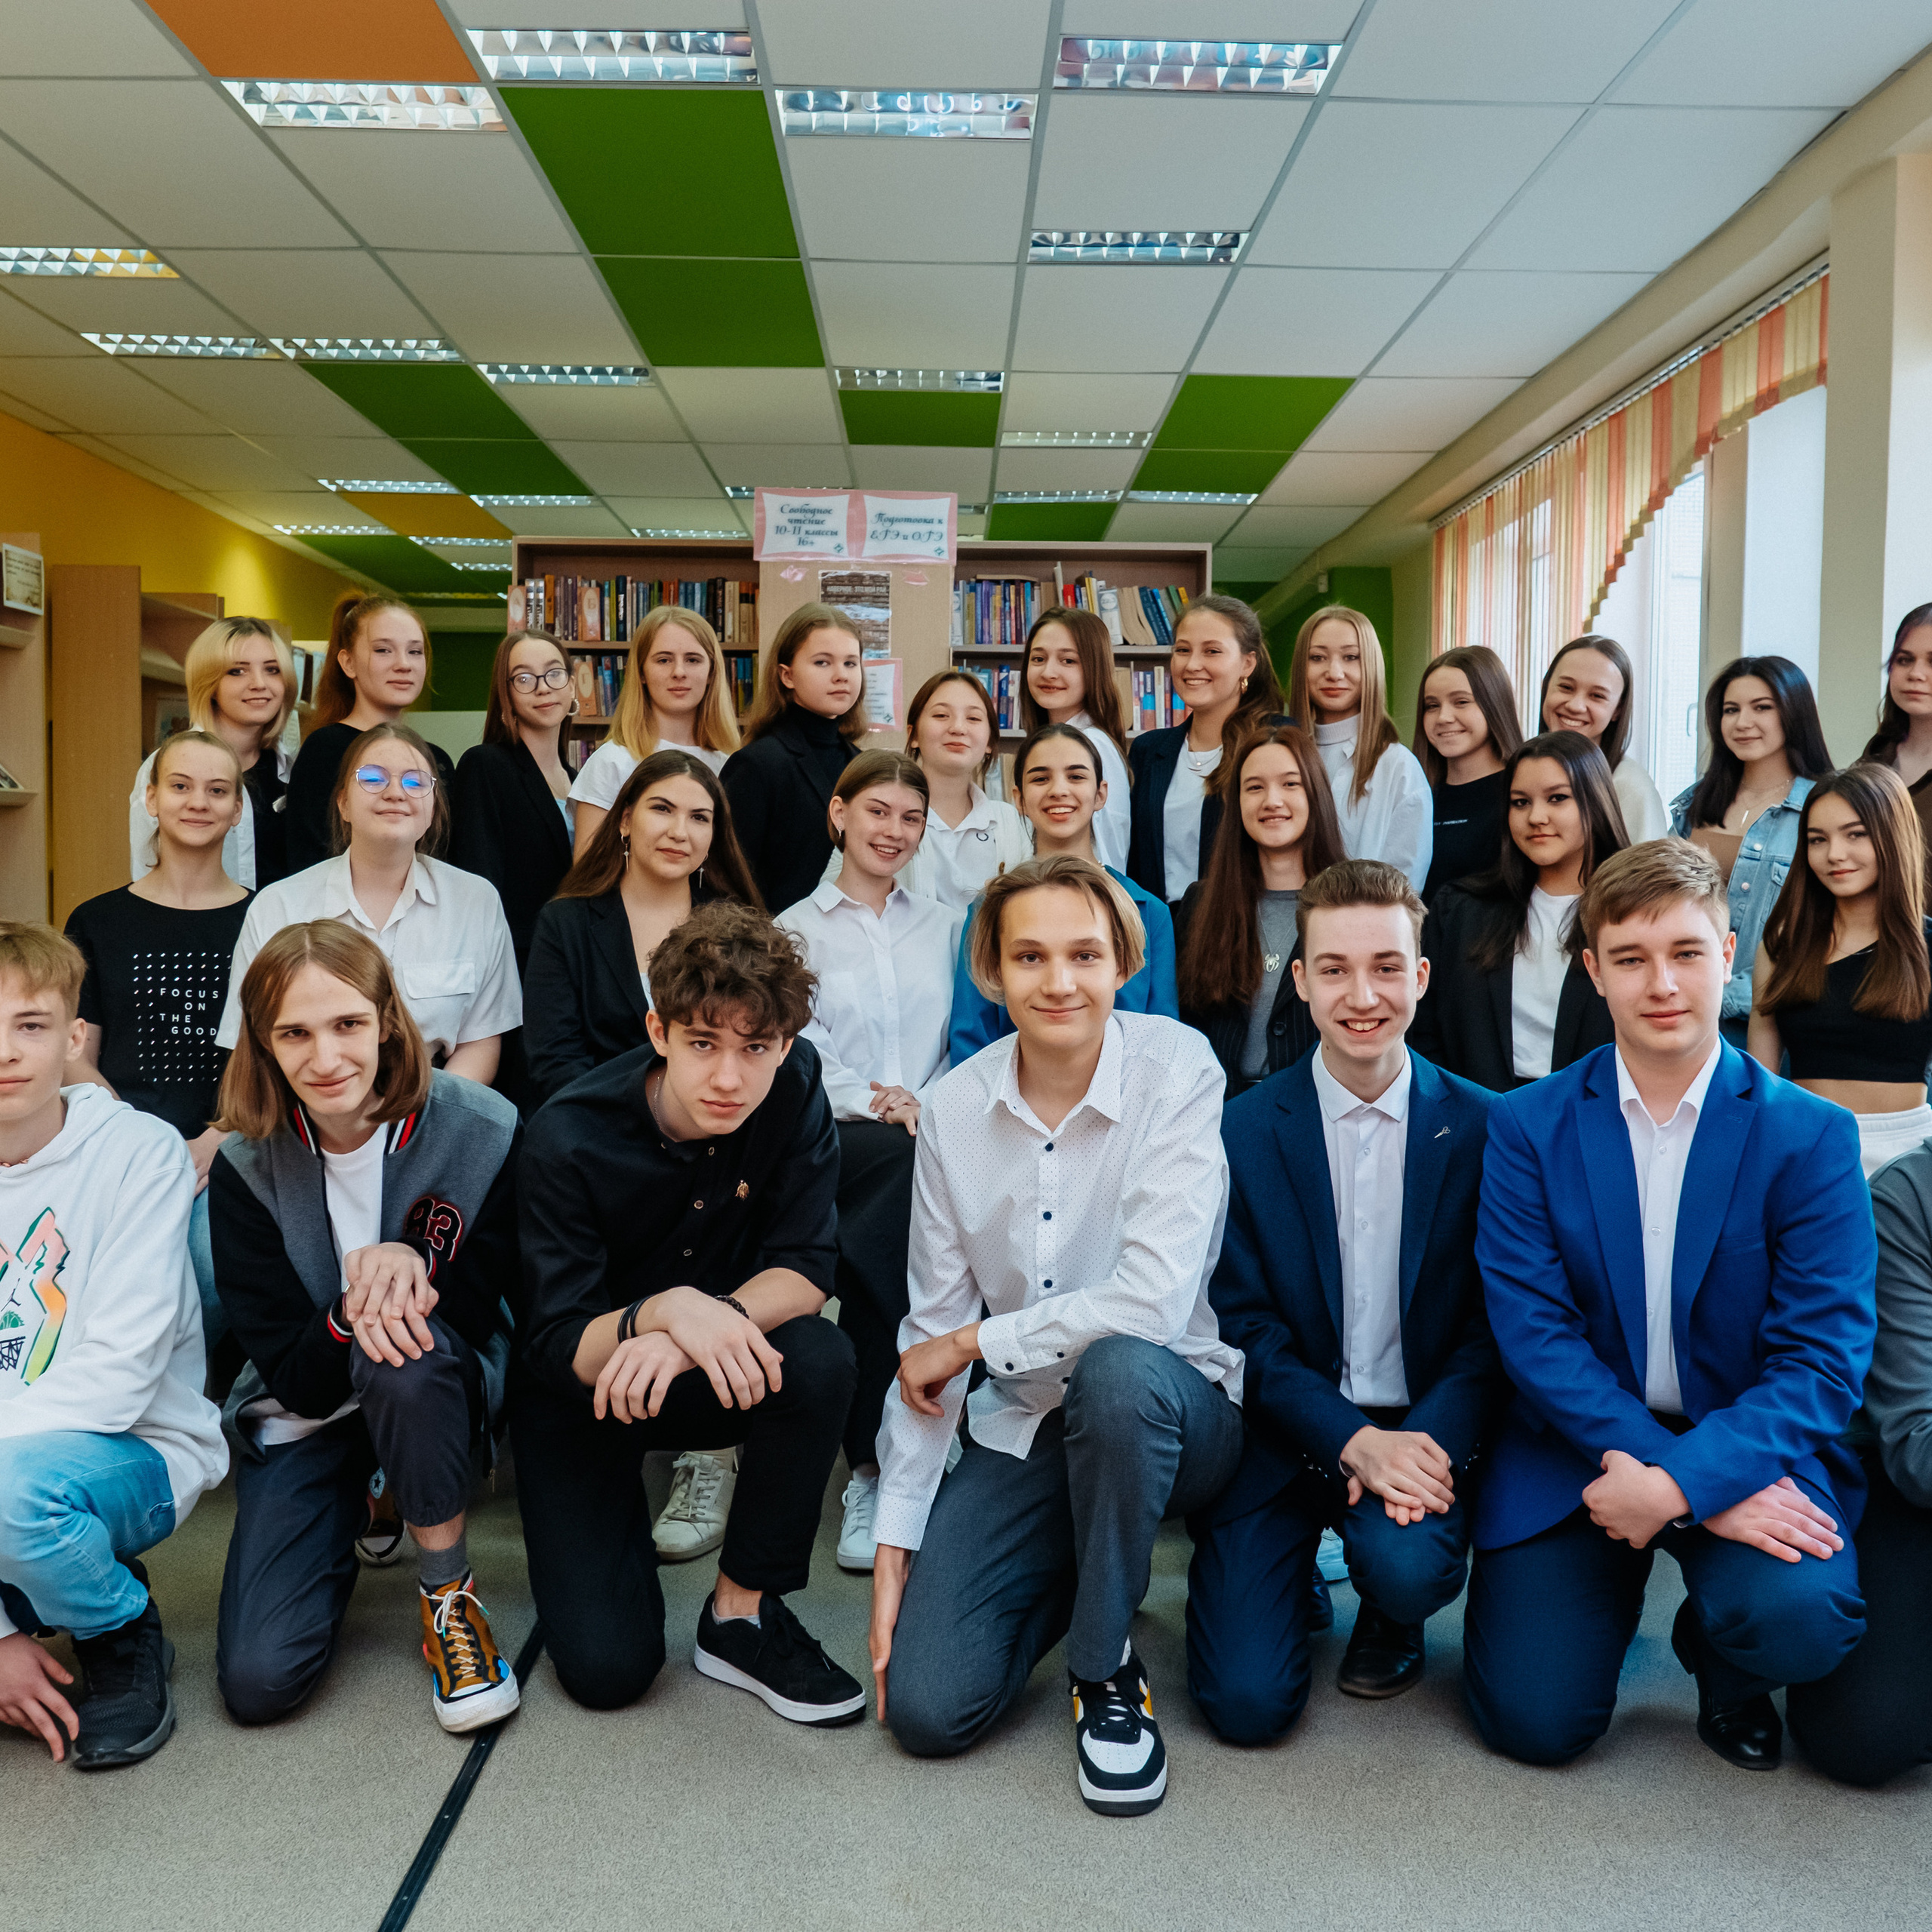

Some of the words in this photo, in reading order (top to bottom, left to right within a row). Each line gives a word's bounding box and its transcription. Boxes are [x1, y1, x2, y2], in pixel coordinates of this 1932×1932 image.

[780, 503, 832, 518] Свободное
[871, 512, 934, 528] Подготовка
[775, 525, 801, 535] 10-11
[870, 528, 900, 541] ЕГЭ
[912, 530, 943, 543] ОГЭ
[797, 537, 814, 546] 16+
[160, 988, 219, 998] FOCUS
[184, 1002, 205, 1011] ON
[159, 1013, 191, 1023] THE
[171, 1026, 217, 1036] GOOD
